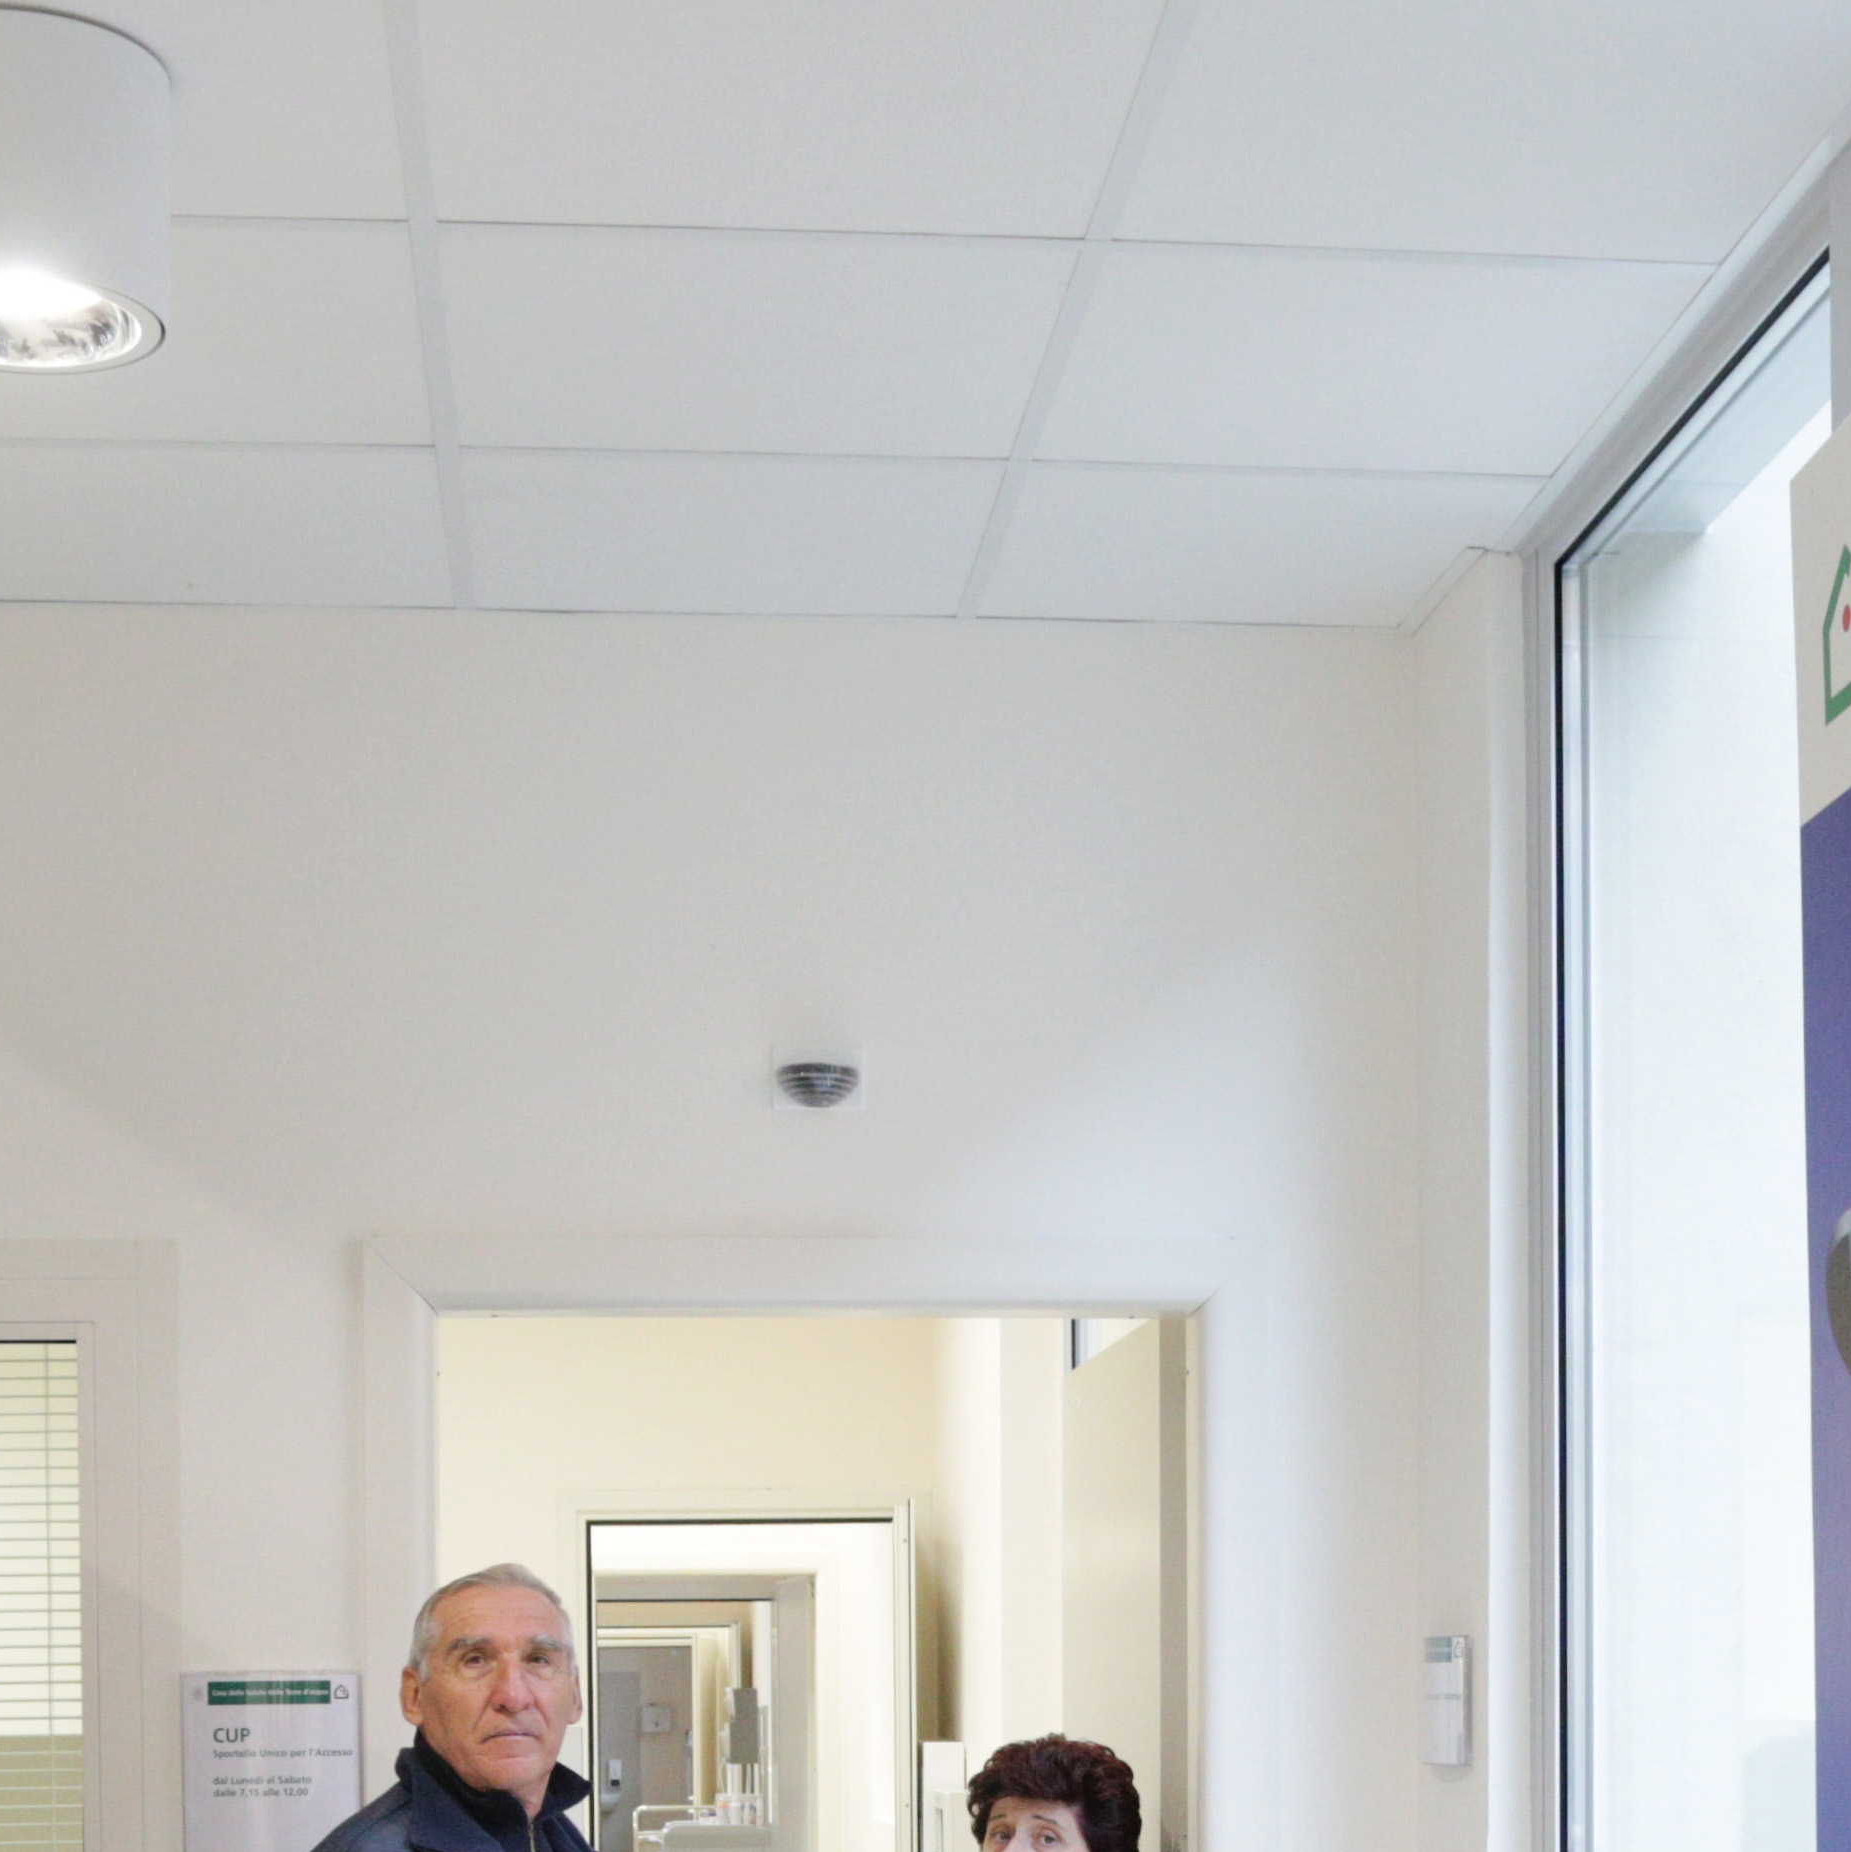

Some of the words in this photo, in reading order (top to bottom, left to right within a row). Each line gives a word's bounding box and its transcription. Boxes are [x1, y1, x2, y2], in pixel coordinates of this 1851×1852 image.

[213, 1728, 250, 1743] CUP
[213, 1750, 256, 1760] Sportello
[290, 1750, 306, 1759] per
[213, 1777, 227, 1785] dal
[231, 1776, 263, 1785] Lunedì
[266, 1776, 275, 1784] al
[278, 1776, 312, 1784] Sabato
